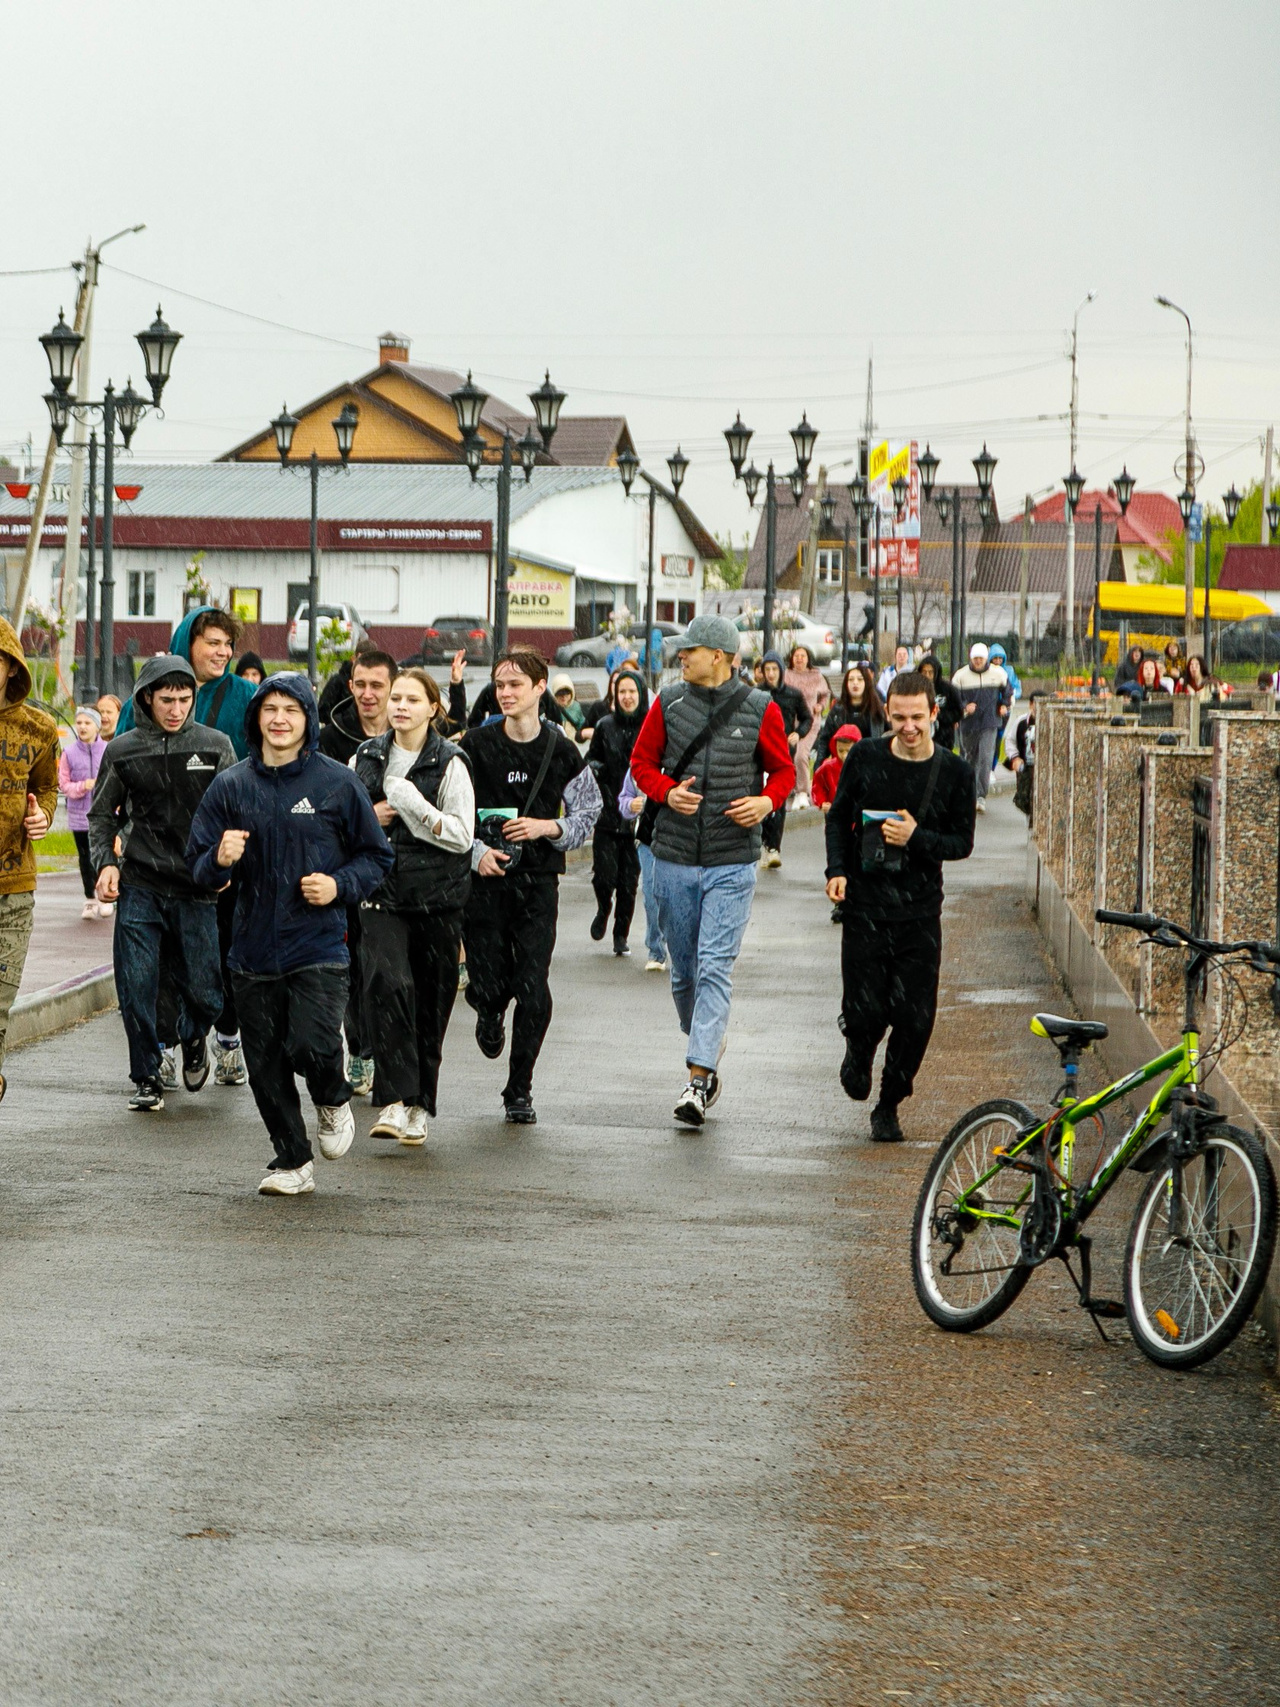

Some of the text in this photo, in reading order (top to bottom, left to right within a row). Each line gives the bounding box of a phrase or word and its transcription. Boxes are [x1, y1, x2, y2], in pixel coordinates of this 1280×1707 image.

[11, 524, 32, 537] ДЛЯ
[506, 581, 563, 592] АПРАВКА
[510, 594, 550, 606] АВТО
[508, 771, 528, 783] GAP
